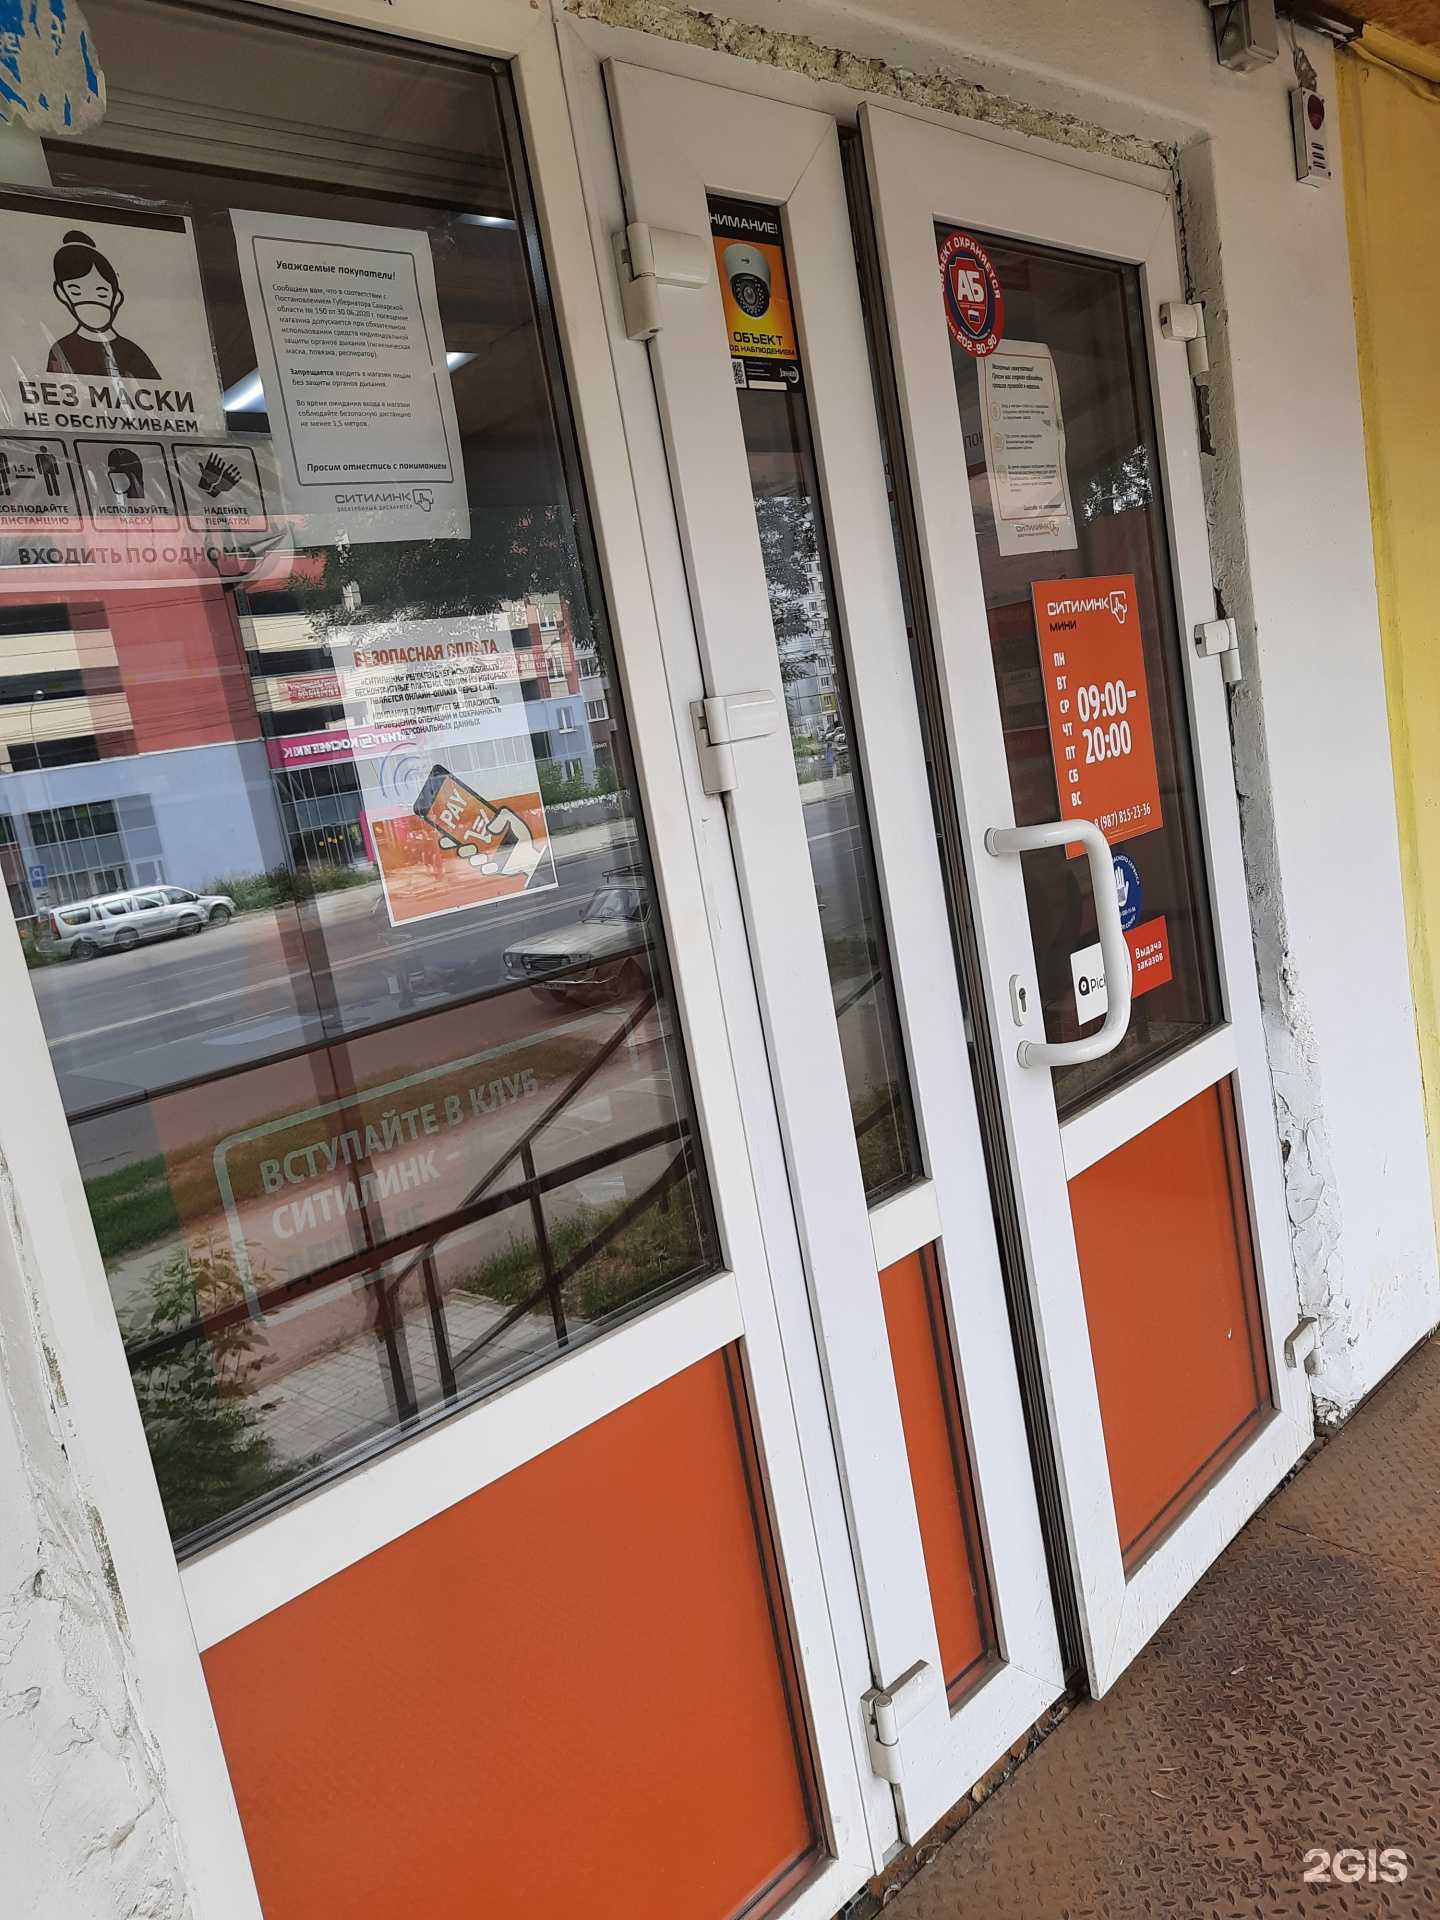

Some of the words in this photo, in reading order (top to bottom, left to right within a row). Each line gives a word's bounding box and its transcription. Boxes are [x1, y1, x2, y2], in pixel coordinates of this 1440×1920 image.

[709, 213, 778, 234] НИМАНИЕ!
[276, 260, 336, 273] Уважаемые
[338, 266, 396, 281] покупатели!
[954, 236, 1001, 299] ОХРАНЯЕТСЯ
[272, 284, 308, 293] Сообщаем
[957, 269, 985, 303] АБ
[275, 294, 331, 304] Постановлением
[277, 305, 304, 313] области
[733, 331, 783, 346] ОБЪЕКТ
[956, 331, 997, 354] 202-90-90
[290, 368, 334, 377] Запрещается
[18, 381, 79, 407] БЕЗ
[88, 385, 195, 413] МАСКИ
[298, 410, 338, 418] соблюдайте
[340, 410, 378, 418] безопасную
[24, 412, 49, 427] НЕ
[55, 413, 200, 433] ОБСЛУЖИВАЕМ
[13, 462, 24, 473] 1,5
[307, 463, 342, 473] Просим
[343, 463, 392, 472] отнестись
[400, 463, 447, 471] пониманием
[335, 492, 412, 504] СИТИЛИНК
[99, 504, 170, 515] ИСПОЛЬЗУЙТЕ
[203, 506, 249, 516] НАДЕНЬТЕ
[1, 517, 69, 526] ДИСТАНЦИЮ
[119, 517, 153, 526] МАСКУ
[205, 517, 250, 527] ПЕРЧАТКИ
[19, 548, 122, 565] ВХОДИТЬ
[127, 547, 158, 564] ПО
[1047, 597, 1109, 616] СИТИЛИНК
[1049, 619, 1077, 633] МИНИ
[354, 645, 443, 667] БЕЗОПАСНАЯ
[447, 639, 499, 659] ОПЛАТА
[1053, 652, 1066, 667] ПН
[1056, 676, 1067, 691] ВТ
[1059, 699, 1070, 714] СР
[400, 723, 453, 737] ПЕРСОНАЛЬНЫХ
[453, 719, 481, 729] ДАННЫХ
[1062, 722, 1073, 737] ЧТ
[1082, 719, 1132, 765] 20:00
[1065, 745, 1076, 761] ПТ
[1068, 768, 1079, 783] СБ
[1071, 791, 1082, 807] ВС
[439, 788, 467, 829] PAY
[1100, 811, 1118, 831] (987)
[1119, 802, 1151, 823] 815-23-36
[1135, 940, 1162, 959] Выдача
[1136, 952, 1164, 971] заказов
[1090, 977, 1106, 992] Pic
[259, 1103, 440, 1194] ВСТУПАЙТЕ
[445, 1096, 465, 1127] В
[468, 1068, 540, 1115] КЛУБ
[270, 1150, 440, 1239] СИТИЛИНК
